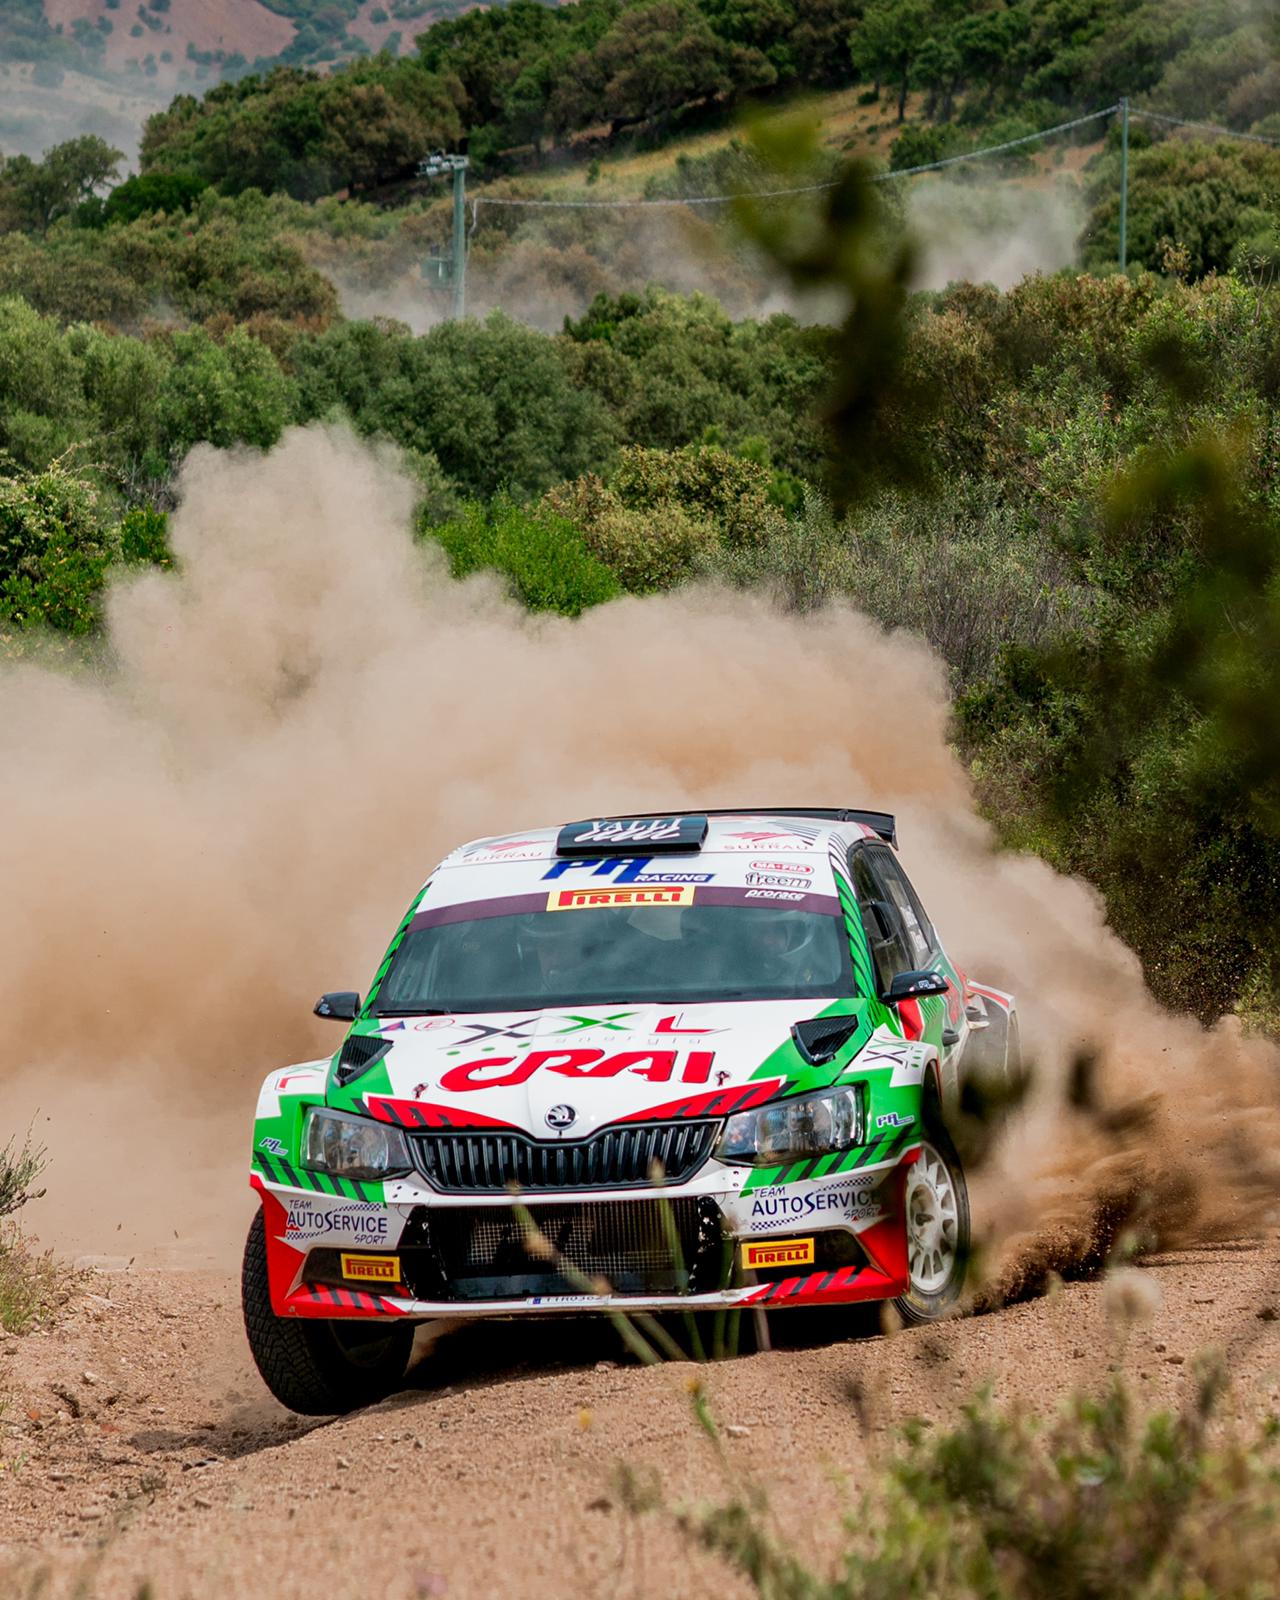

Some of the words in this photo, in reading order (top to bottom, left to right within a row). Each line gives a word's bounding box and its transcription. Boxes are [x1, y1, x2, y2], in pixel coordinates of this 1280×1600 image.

[633, 873, 709, 883] RACING
[558, 886, 685, 907] PIRELLI
[437, 1048, 716, 1092] CRAI
[753, 1187, 786, 1198] TEAM
[289, 1200, 312, 1209] TEAM
[752, 1189, 881, 1217] AUTOSERVICE
[287, 1211, 388, 1234] AUTOSERVICE
[844, 1206, 881, 1220] SPORT
[354, 1234, 387, 1245] SPORT
[749, 1243, 809, 1264] PIRELLI
[346, 1258, 394, 1277] PIRELLI
